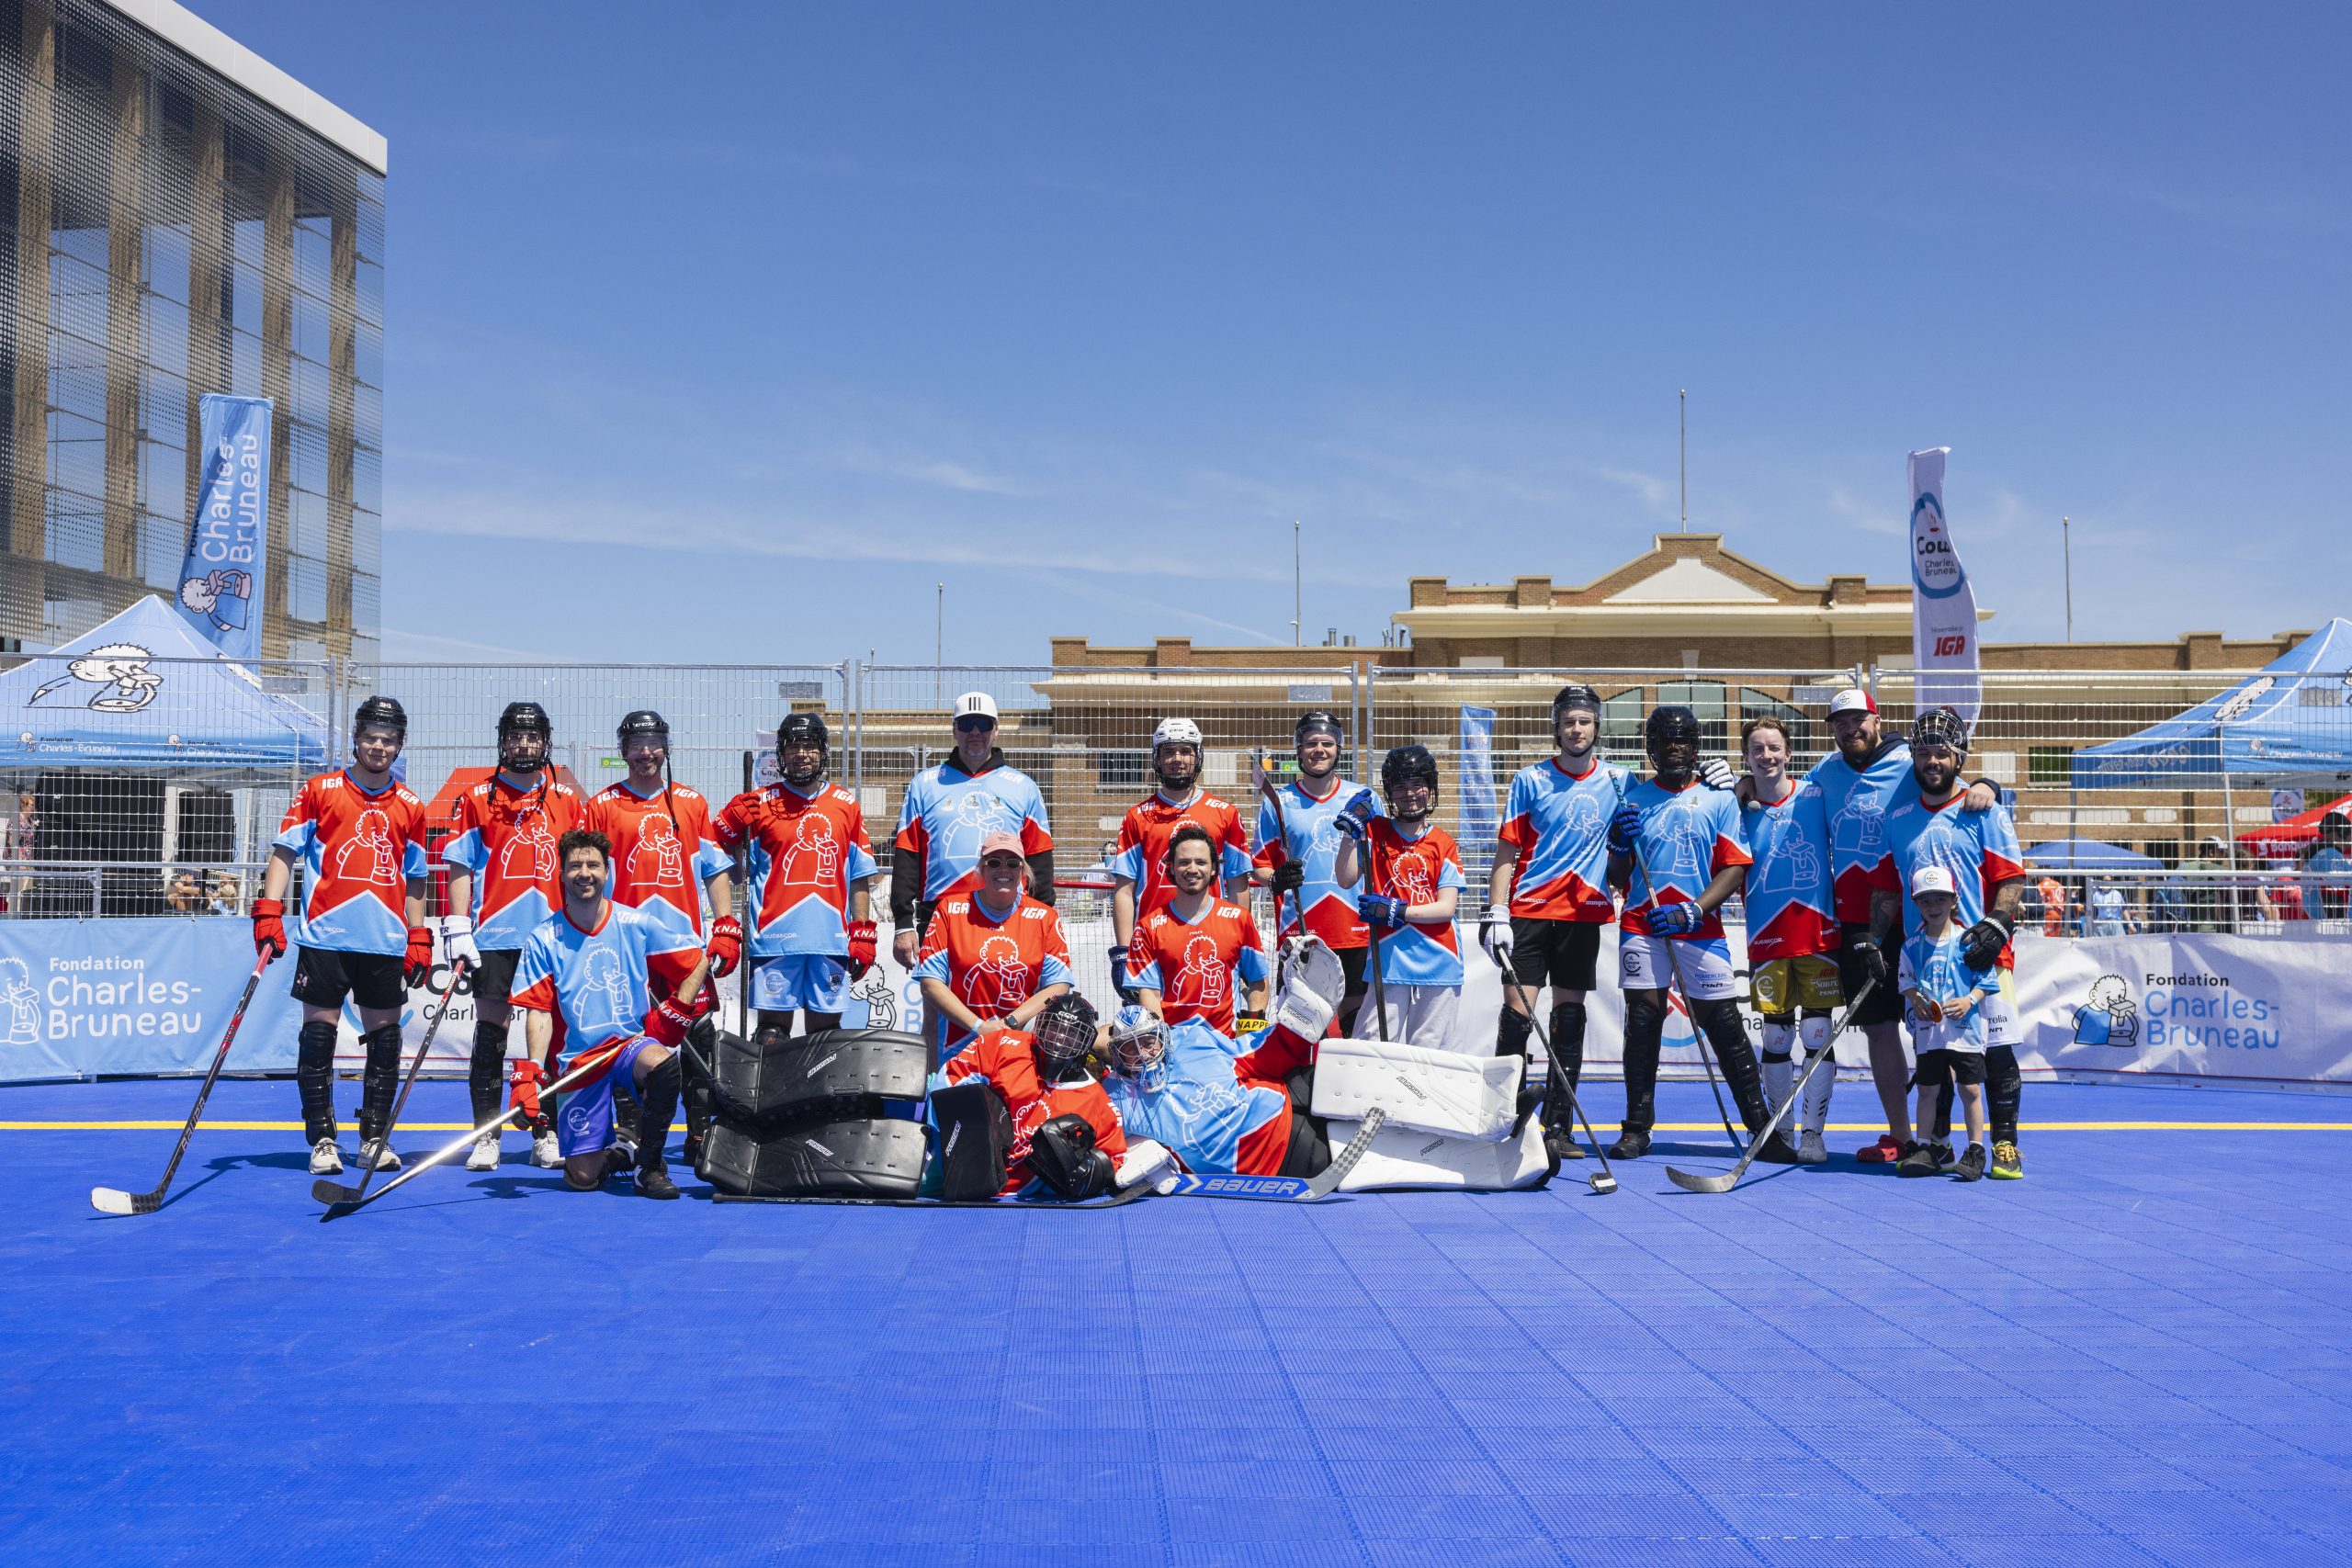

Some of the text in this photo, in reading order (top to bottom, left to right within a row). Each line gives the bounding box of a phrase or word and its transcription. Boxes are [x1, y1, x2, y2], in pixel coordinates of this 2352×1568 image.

[229, 434, 258, 563] Bruneau
[1933, 635, 1966, 657] IGA
[322, 776, 344, 790] IGA
[999, 770, 1025, 784] IGA
[395, 788, 420, 806] IGA
[596, 788, 620, 804] IGA
[673, 787, 699, 800] IGA
[831, 789, 856, 805] IGA
[1204, 797, 1229, 810] IGA
[947, 901, 971, 915] IGA
[1021, 907, 1048, 919] IGA
[1216, 906, 1242, 919] IGA
[616, 910, 641, 924] IGA
[49, 955, 145, 972] Fondation
[1819, 967, 1837, 977] IGA
[2146, 973, 2230, 987] Fondation
[47, 972, 202, 1008] Charles-
[2144, 989, 2280, 1021] Charles-
[1057, 1010, 1079, 1021] CCM
[47, 1008, 202, 1041] Bruneau
[2145, 1021, 2280, 1050] Bruneau
[1204, 1179, 1301, 1195] BAUER
